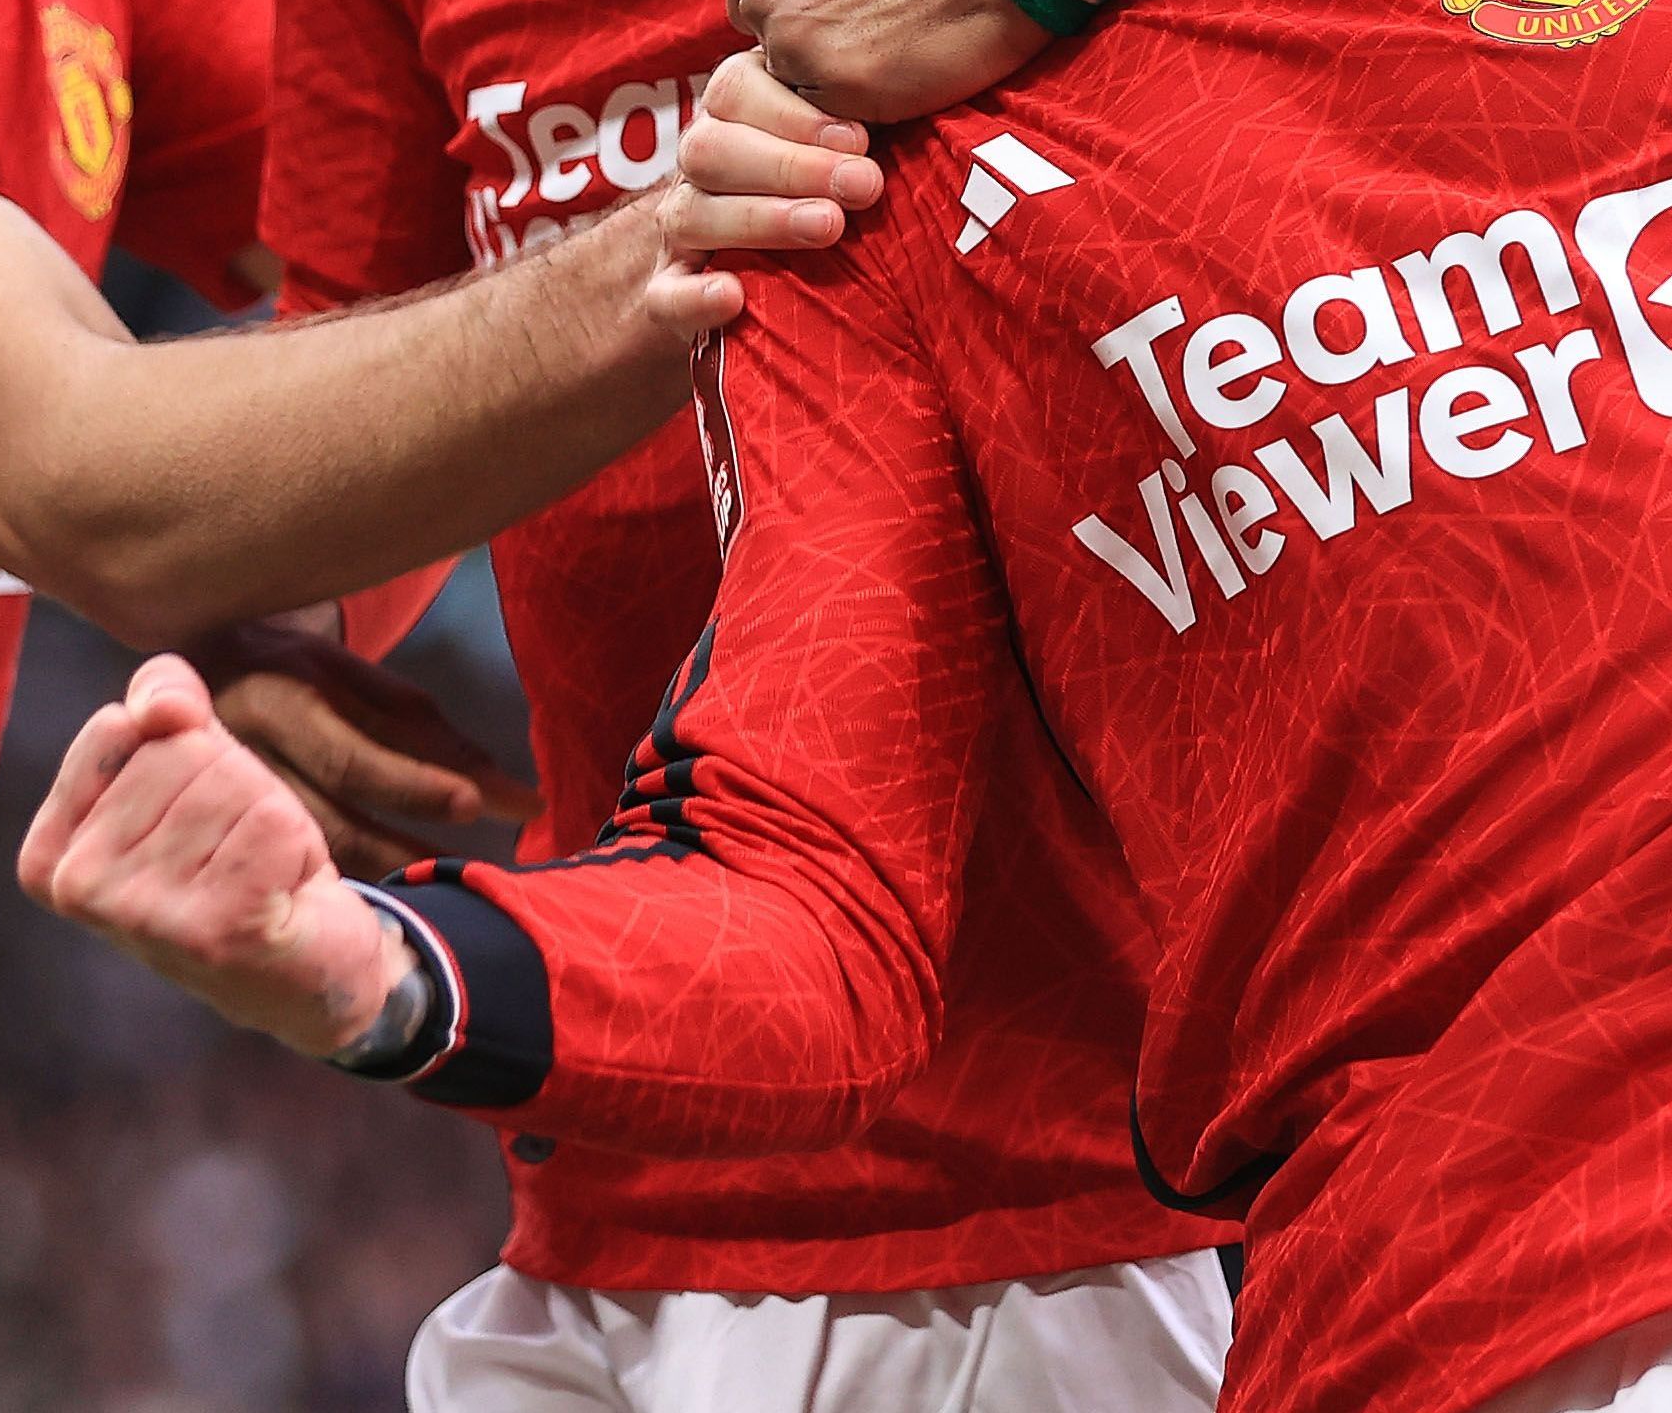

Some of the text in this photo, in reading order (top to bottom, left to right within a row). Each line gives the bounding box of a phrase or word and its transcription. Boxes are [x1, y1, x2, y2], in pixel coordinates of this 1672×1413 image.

[466, 78, 716, 209] Tea
[1091, 208, 1582, 460] Team
[1071, 326, 1603, 635] Viewer
